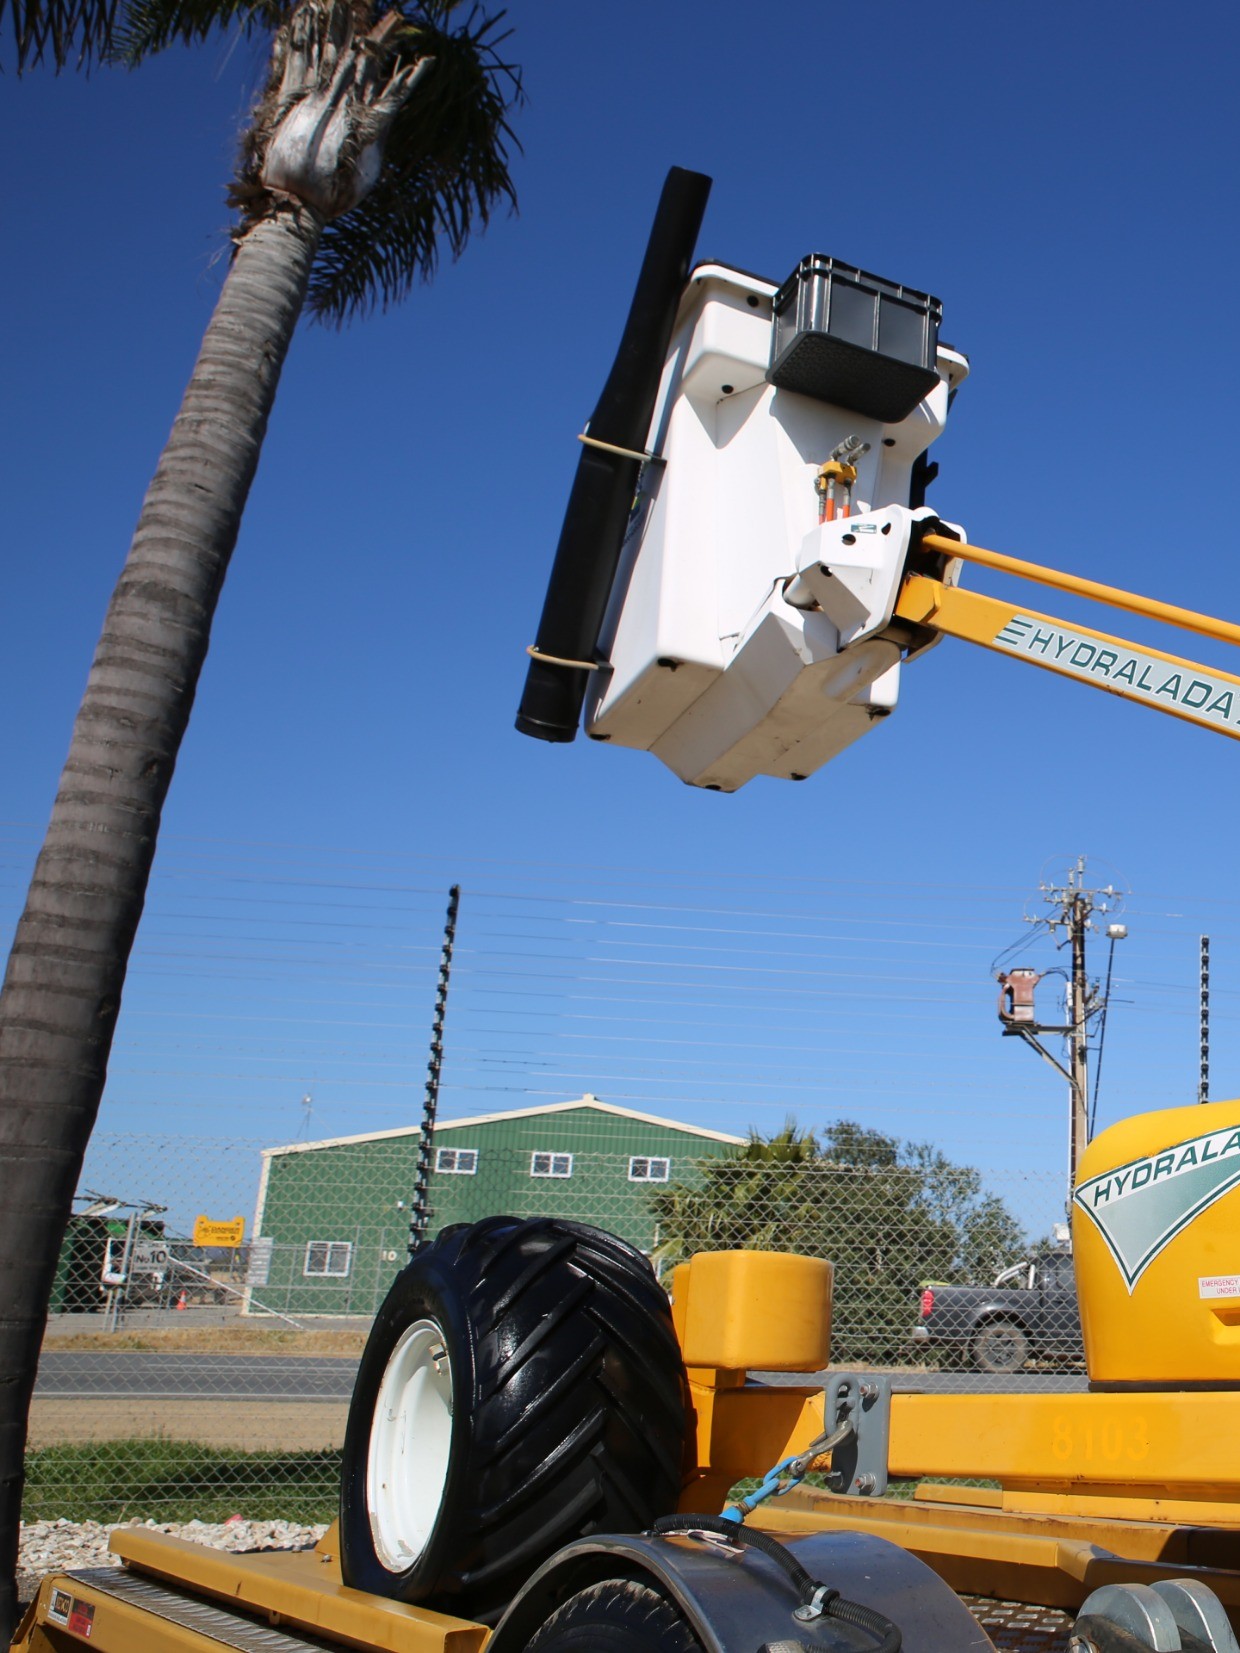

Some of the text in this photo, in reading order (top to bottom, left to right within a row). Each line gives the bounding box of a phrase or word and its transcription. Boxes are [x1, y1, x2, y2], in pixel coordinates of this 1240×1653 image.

[1028, 628, 1234, 719] HYDRALADA
[380, 1250, 398, 1261] 10
[1202, 1279, 1238, 1288] EMERGENCY
[1216, 1286, 1237, 1294] UNDER
[1052, 1415, 1149, 1461] 8103
